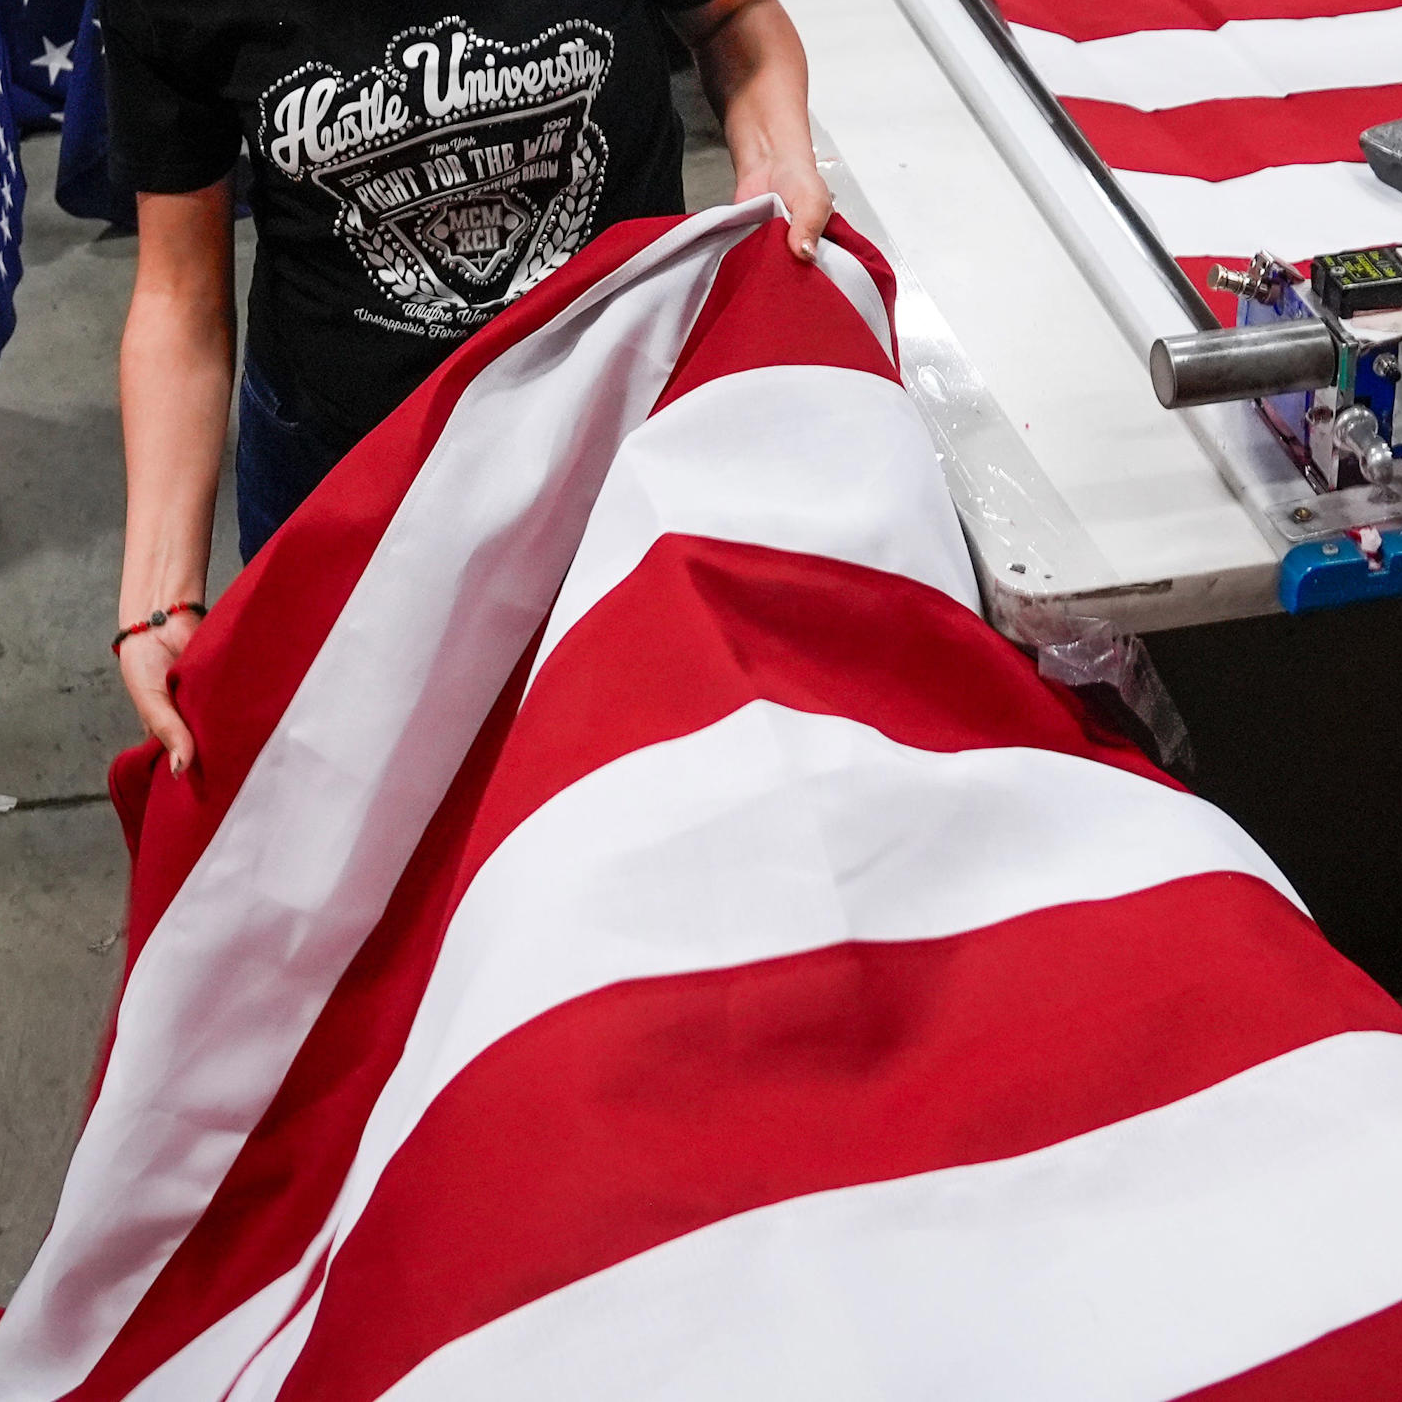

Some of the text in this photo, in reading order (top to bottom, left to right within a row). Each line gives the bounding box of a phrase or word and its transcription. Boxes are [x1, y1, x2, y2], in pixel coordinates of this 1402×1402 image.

[271, 32, 604, 174] Hustle University
[427, 135, 477, 156] New York
[355, 167, 422, 214] FIGHT
[421, 154, 468, 191] FOR
[468, 143, 516, 179] THE
[523, 129, 566, 162] WIN
[522, 159, 559, 182] BELOW
[448, 204, 504, 231] MCM
[353, 307, 426, 336] Unstoppable
[401, 302, 453, 324] Wildfire
